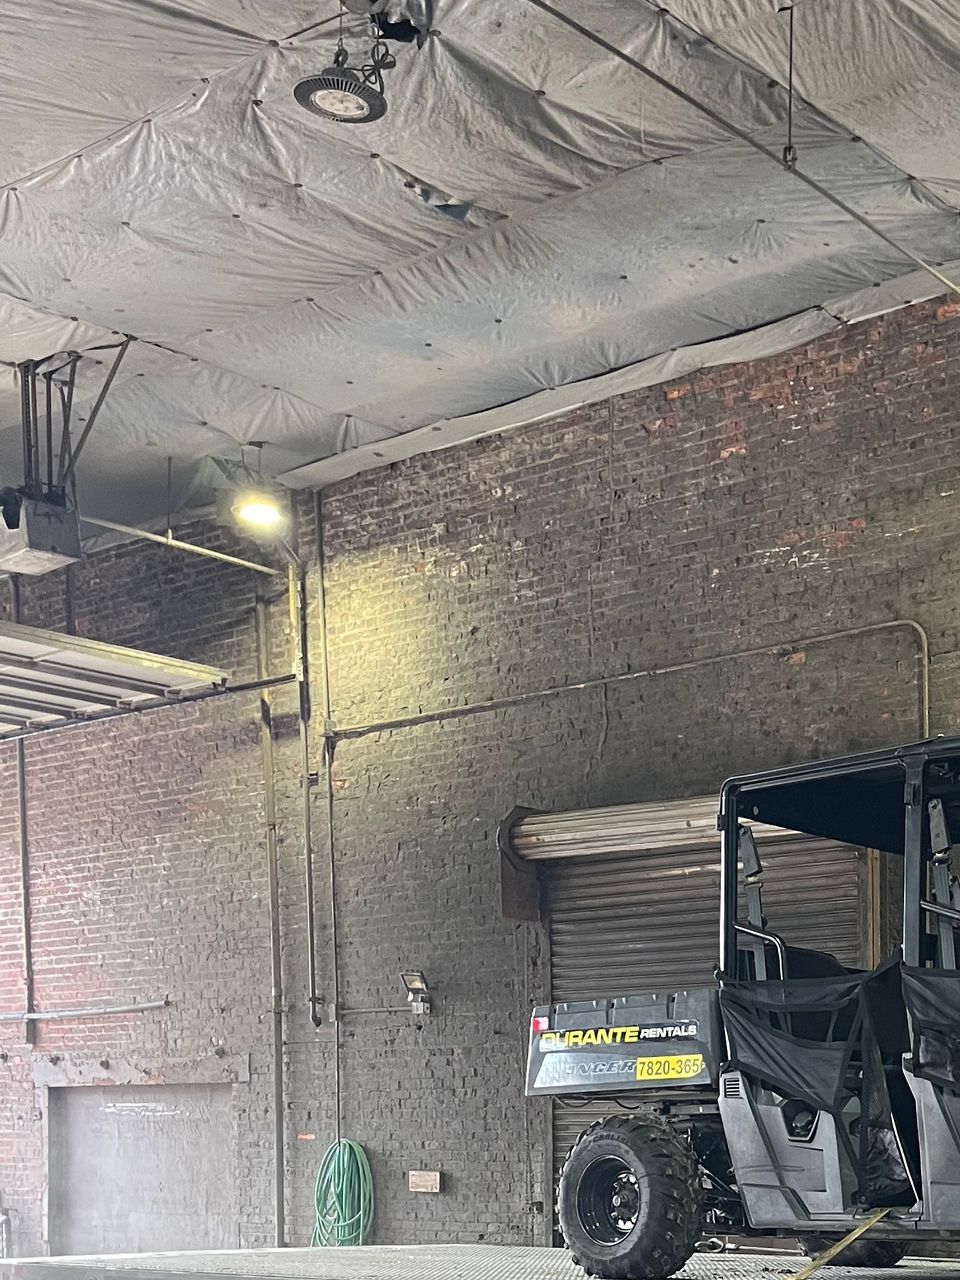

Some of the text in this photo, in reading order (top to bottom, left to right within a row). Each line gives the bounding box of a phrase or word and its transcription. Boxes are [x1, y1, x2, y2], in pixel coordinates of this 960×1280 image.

[540, 1025, 697, 1048] DURANTE RENTALS
[639, 1058, 700, 1076] 7820-365
